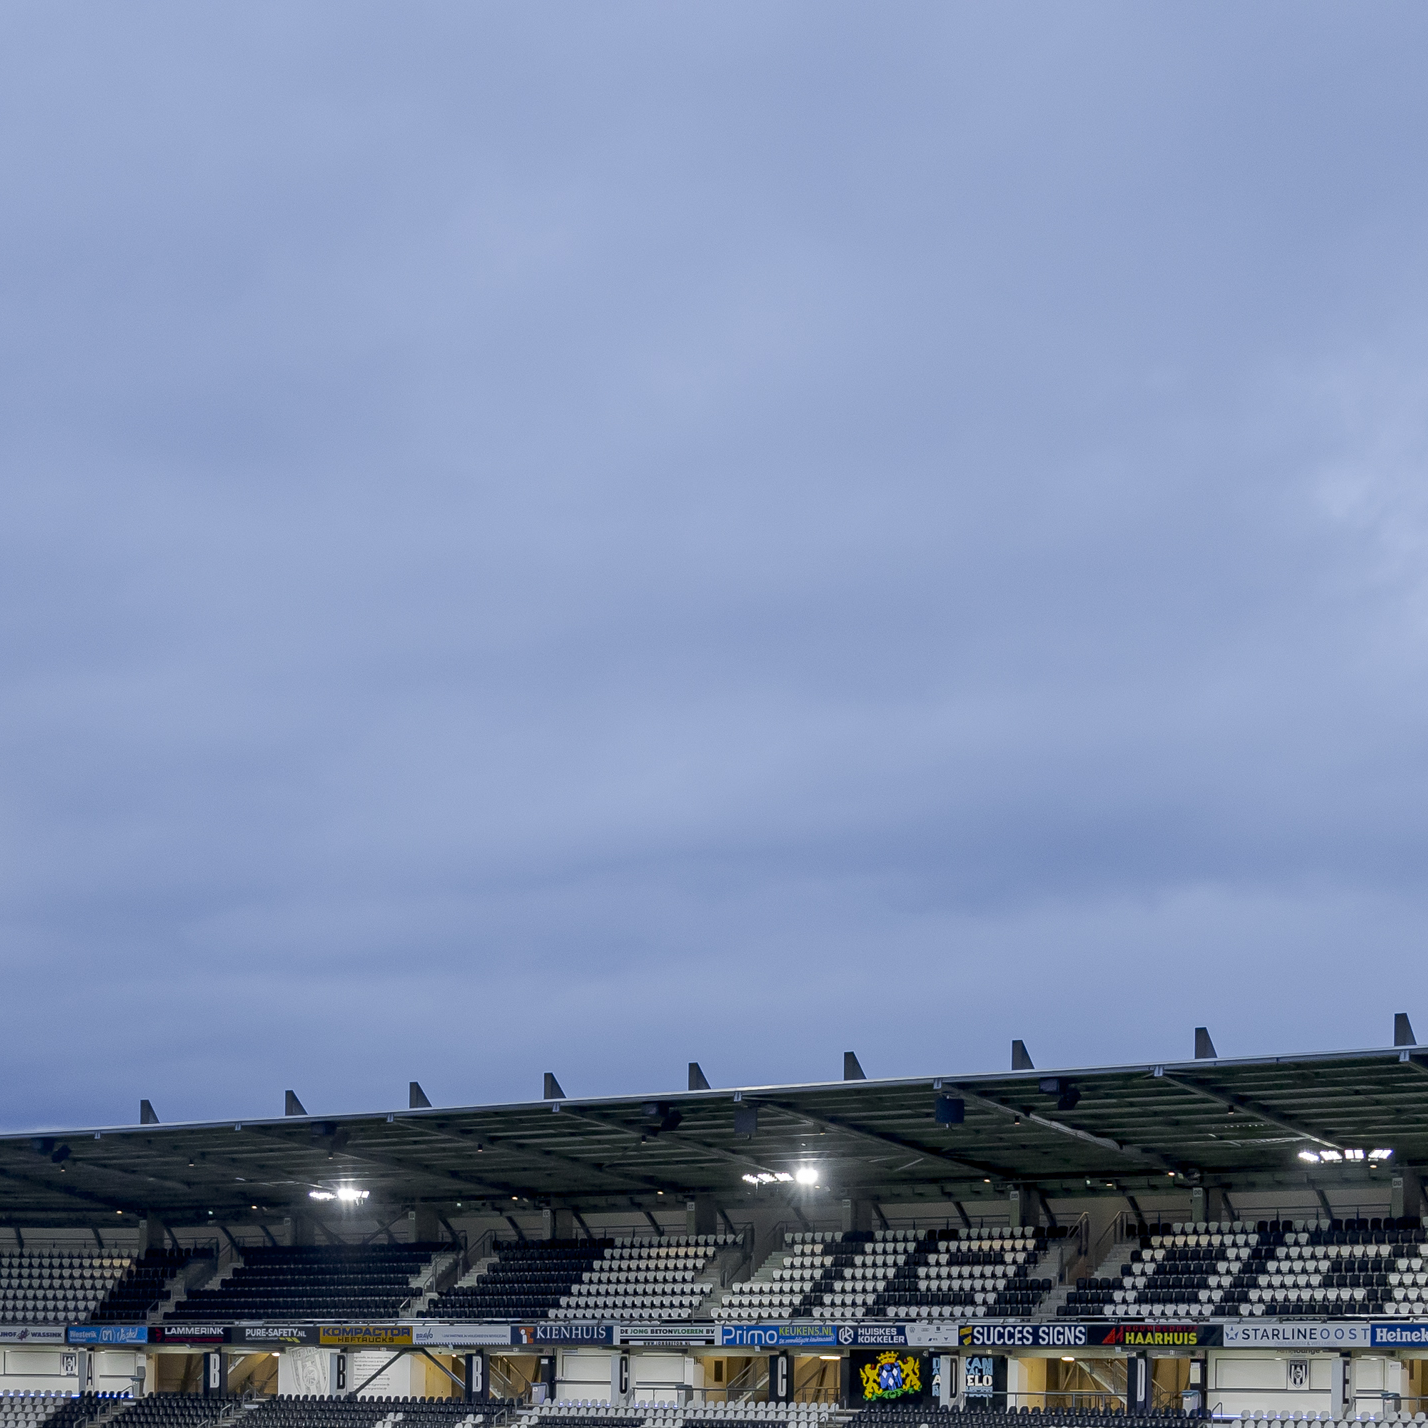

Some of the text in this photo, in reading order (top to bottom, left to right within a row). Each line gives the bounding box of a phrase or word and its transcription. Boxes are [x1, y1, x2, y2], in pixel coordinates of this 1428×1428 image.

[164, 1327, 224, 1335] LAMMERINK
[245, 1328, 307, 1338] PURE-SAFETY.NL
[322, 1326, 411, 1337] KOMPACTOR
[536, 1326, 607, 1339] KIENHUIS
[723, 1326, 778, 1345] Primo
[778, 1326, 834, 1337] KEUKENS.NL
[857, 1327, 897, 1336] HUISKES
[973, 1326, 1033, 1345] SUCCES
[1039, 1326, 1086, 1345] SIGNS
[857, 1336, 905, 1344] KOKKELER
[1125, 1332, 1198, 1345] HAARHUIS
